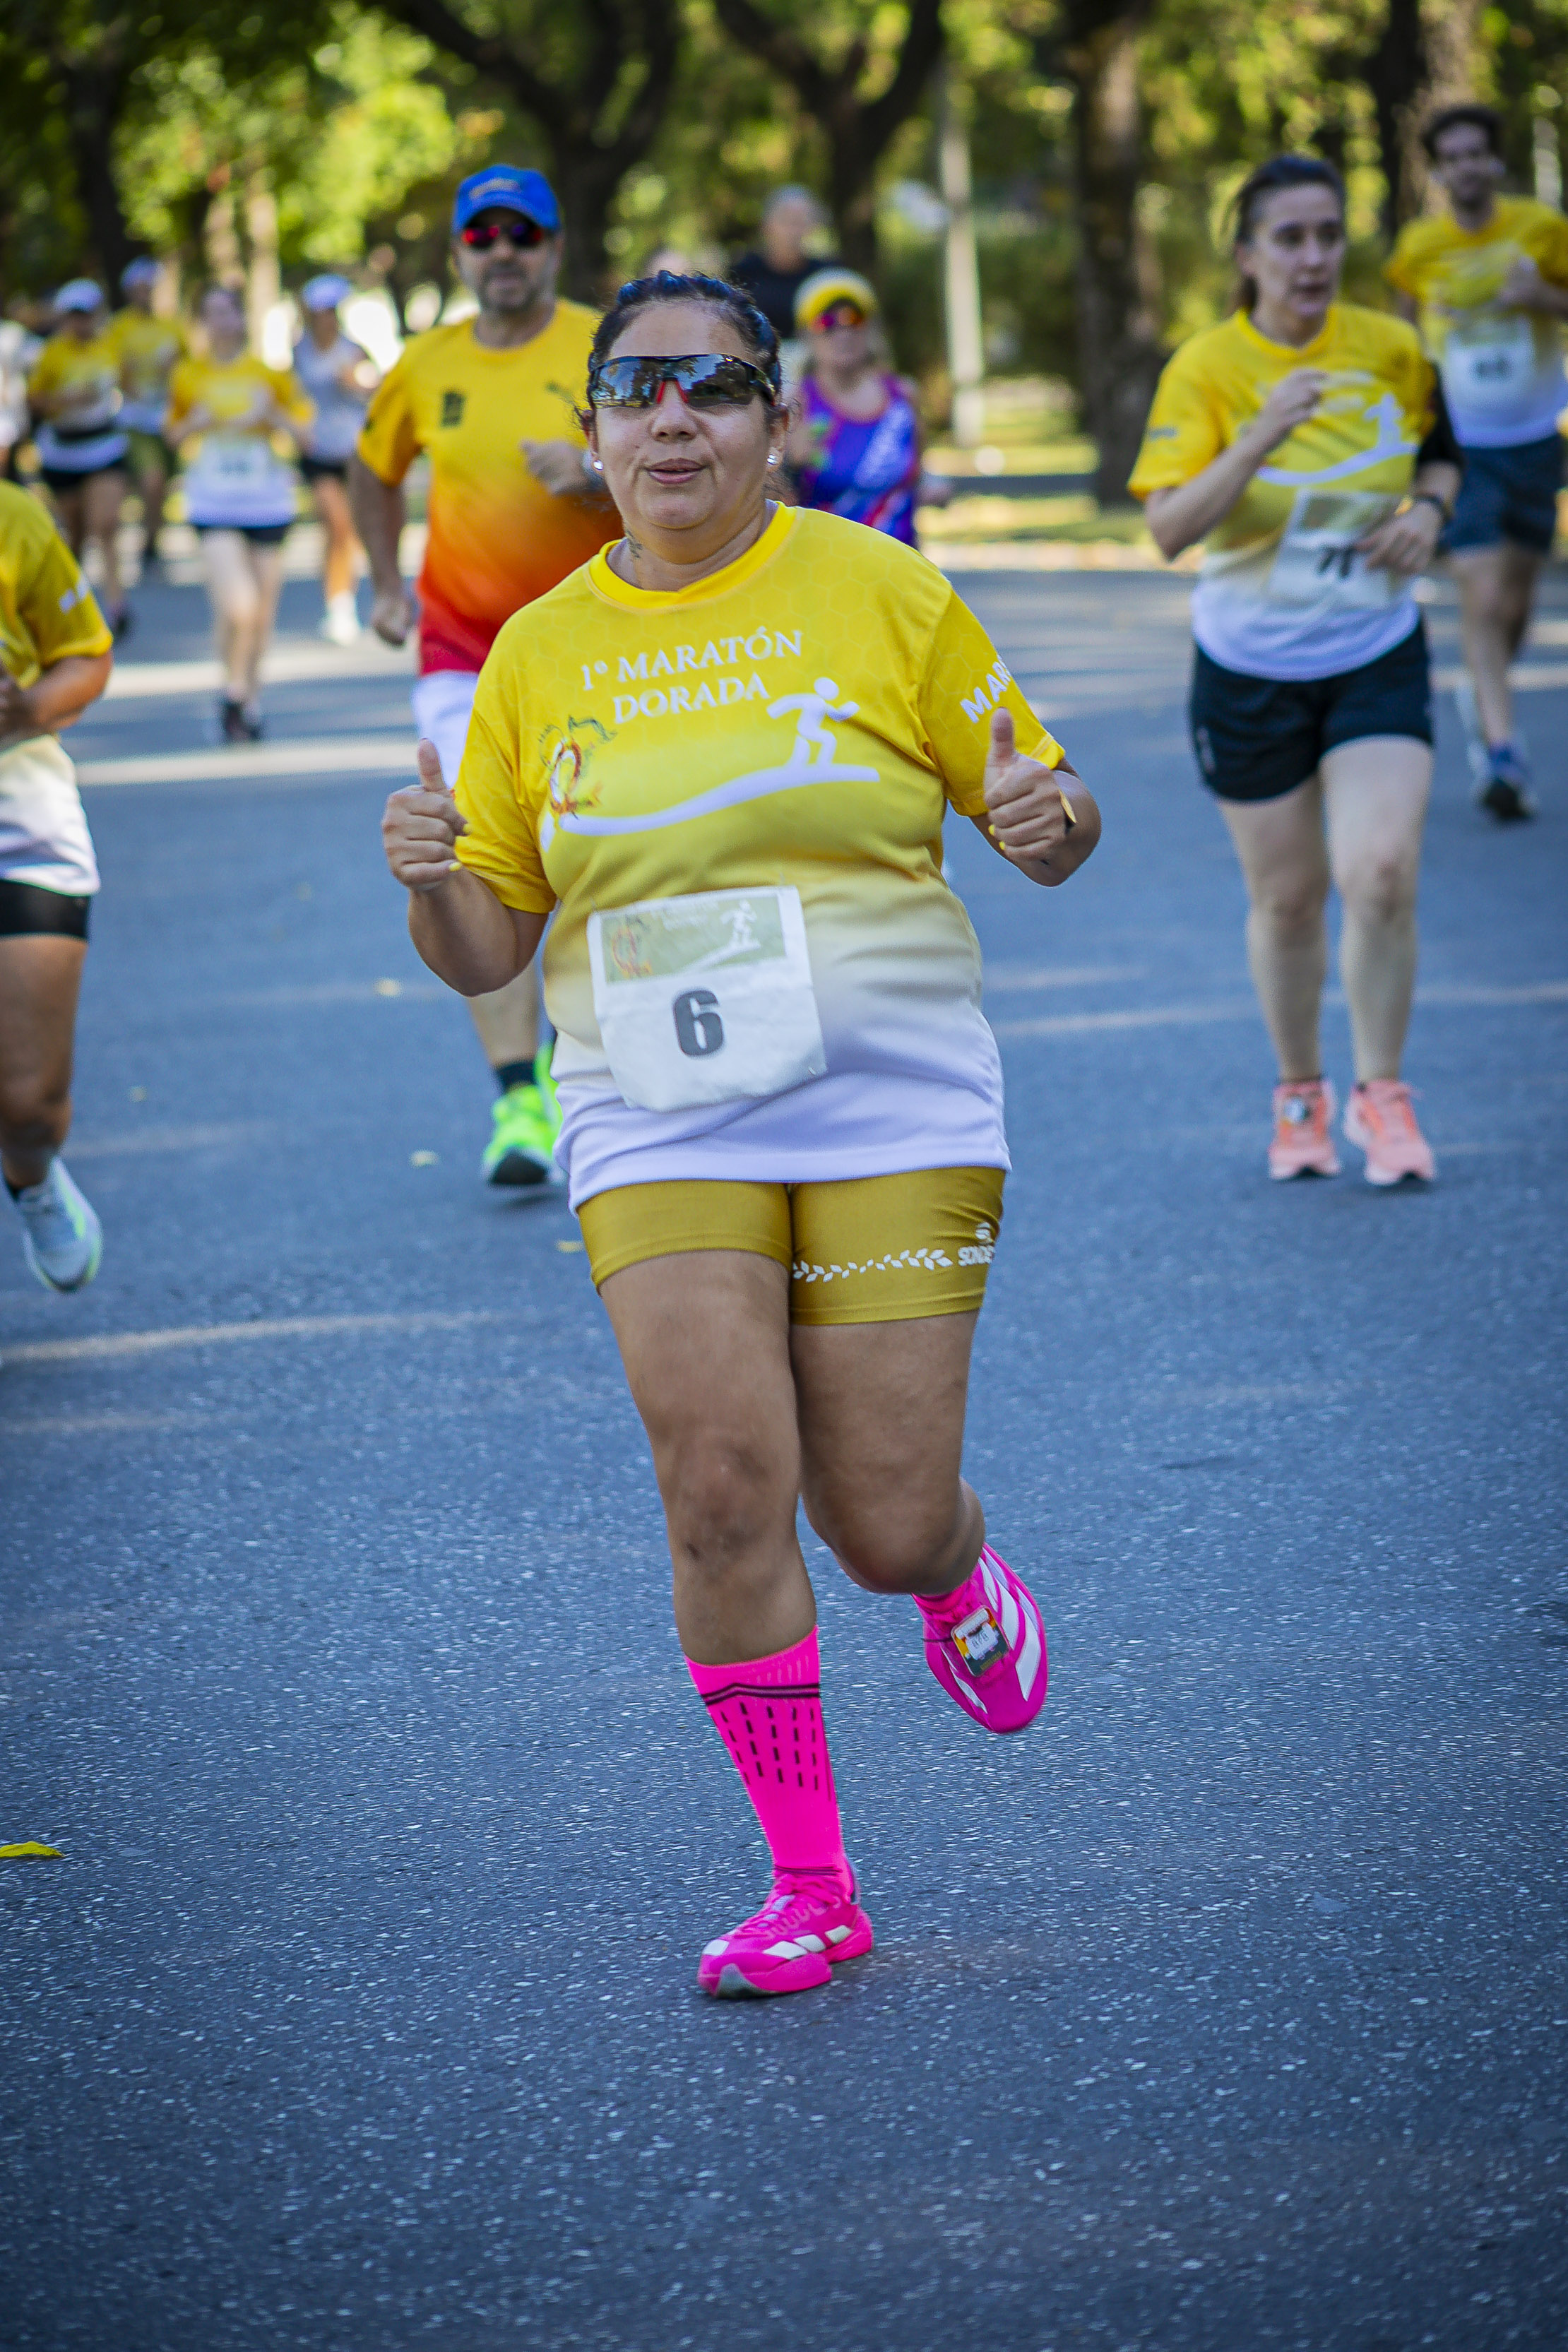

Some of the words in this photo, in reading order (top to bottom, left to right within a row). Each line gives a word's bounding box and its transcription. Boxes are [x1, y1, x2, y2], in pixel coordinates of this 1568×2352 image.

[617, 625, 803, 683] MARATÓN
[613, 671, 771, 724] DORADA
[960, 654, 1011, 724] MAR
[672, 990, 724, 1057] 6
